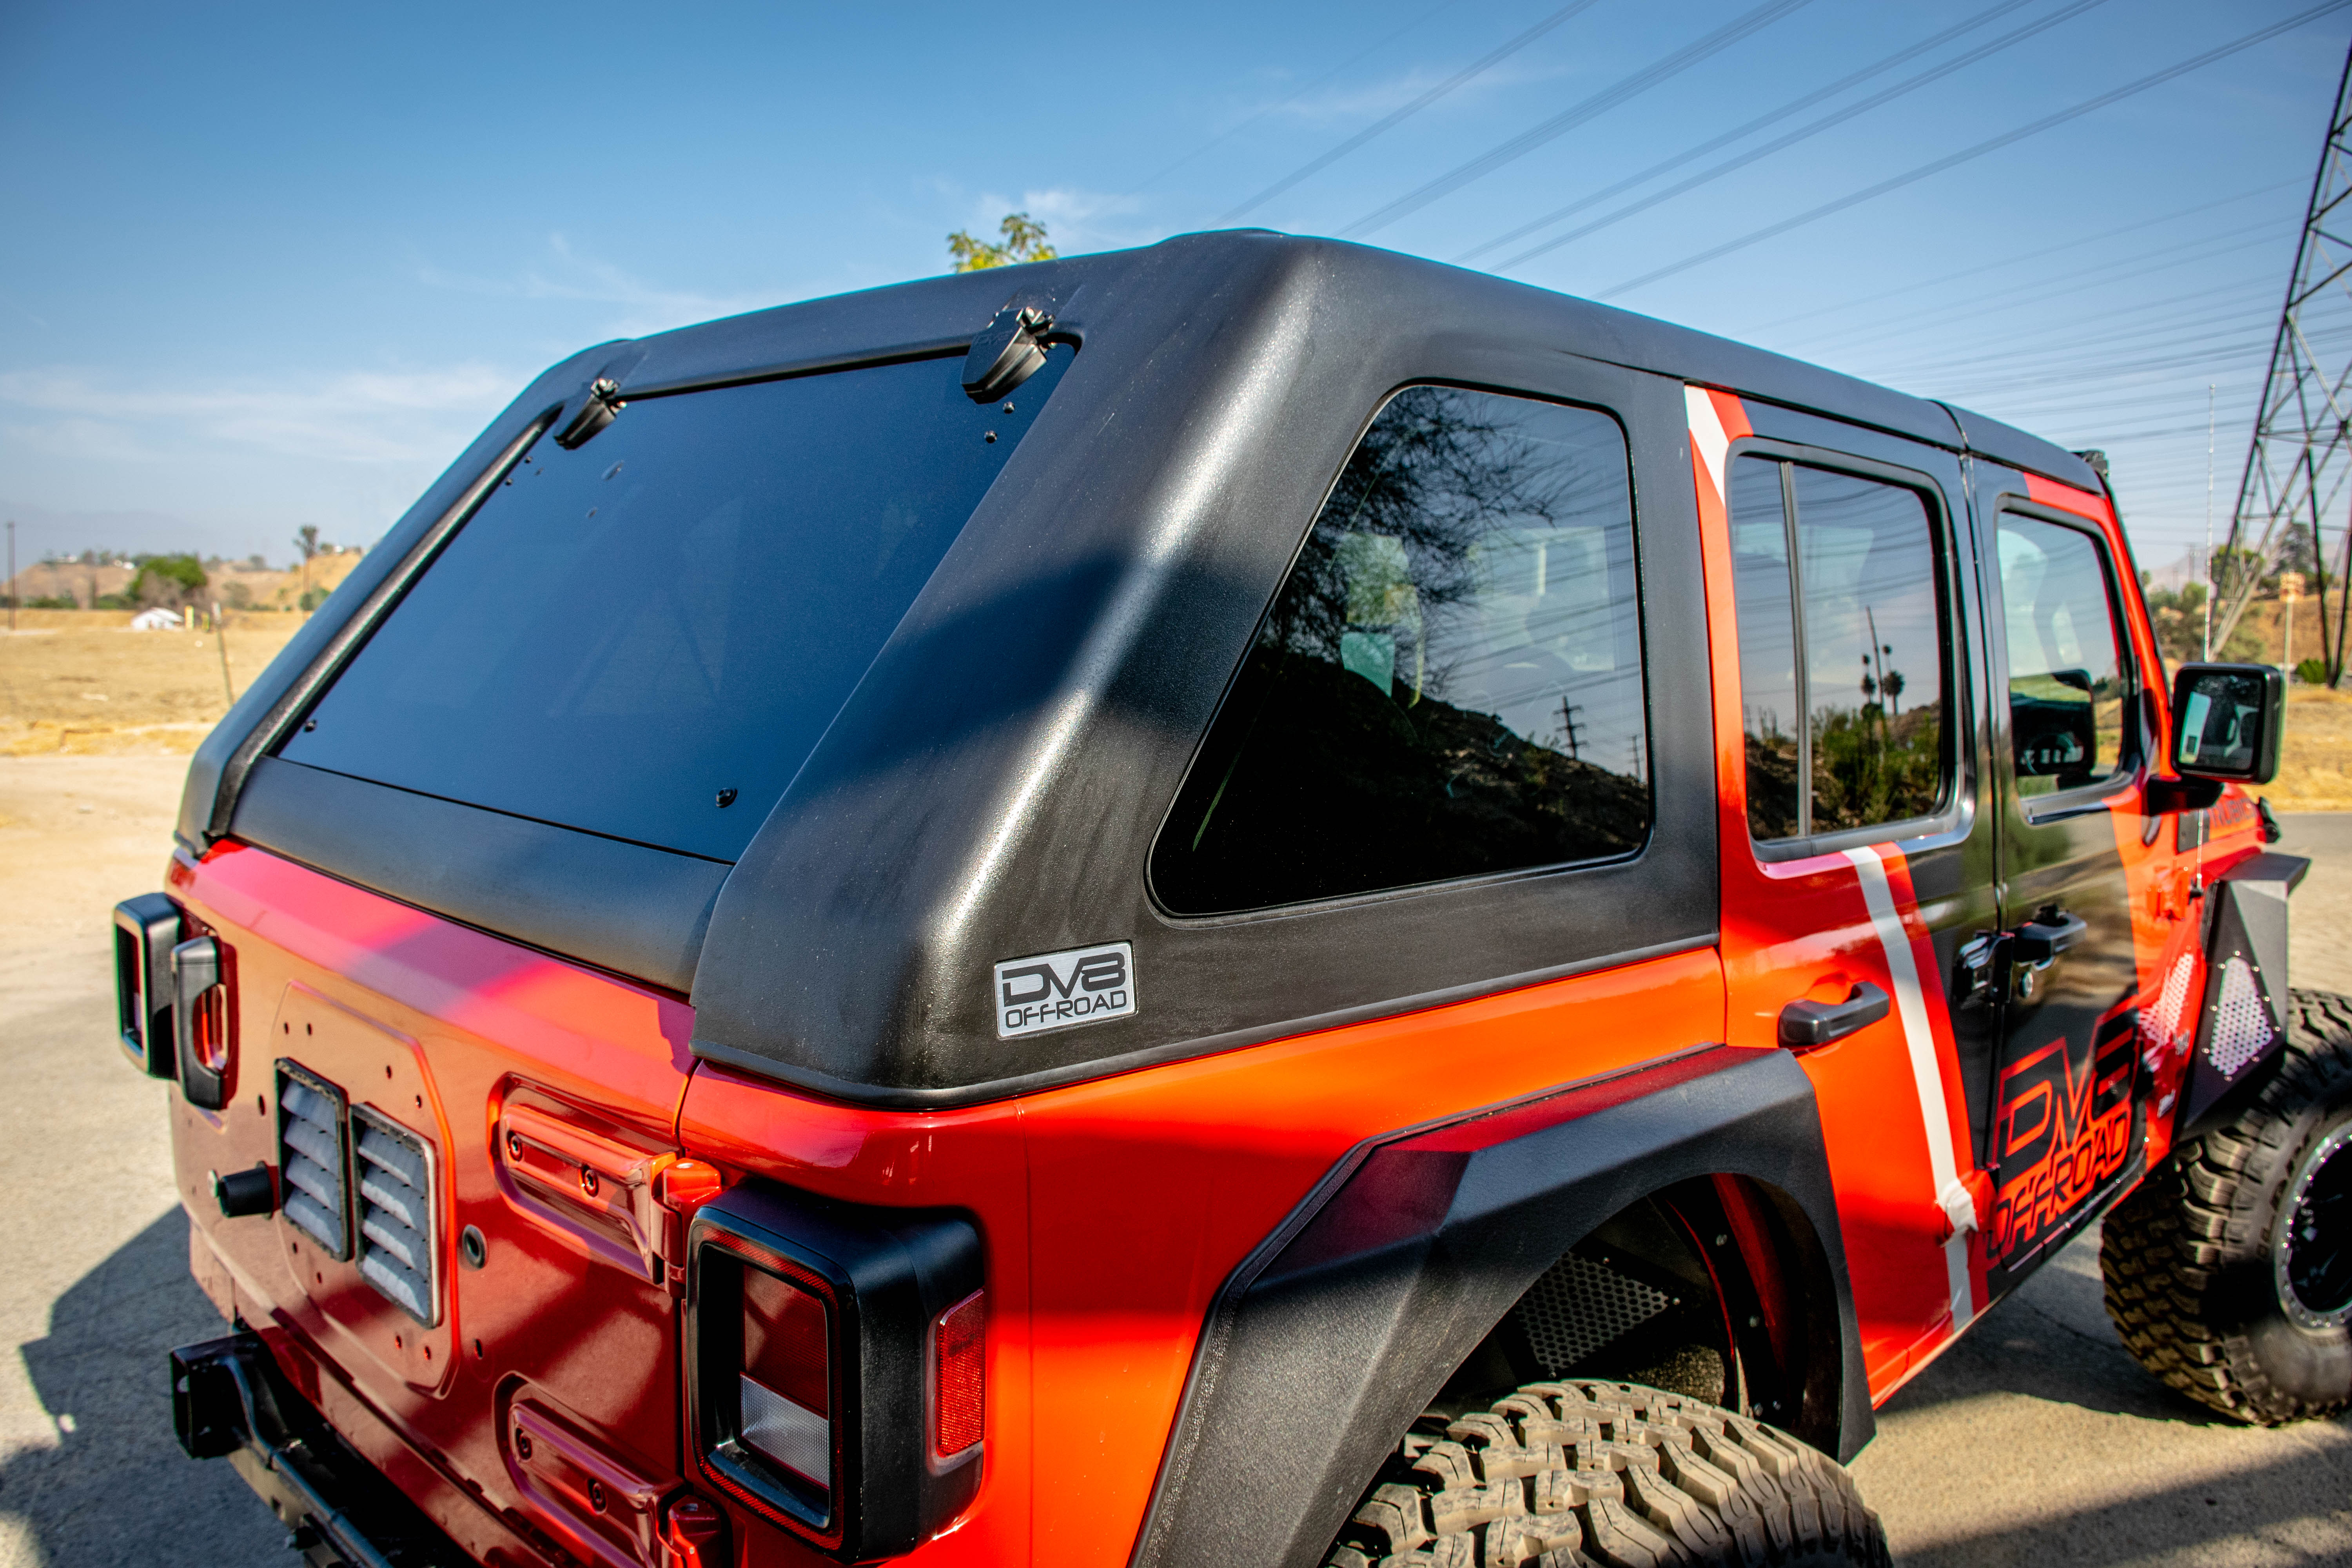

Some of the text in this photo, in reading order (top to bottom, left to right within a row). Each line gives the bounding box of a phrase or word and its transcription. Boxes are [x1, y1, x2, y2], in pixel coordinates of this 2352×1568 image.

[1002, 952, 1125, 1007] DV8
[1005, 990, 1127, 1029] OFFROAD
[1986, 1111, 2128, 1252] OFFROAD
